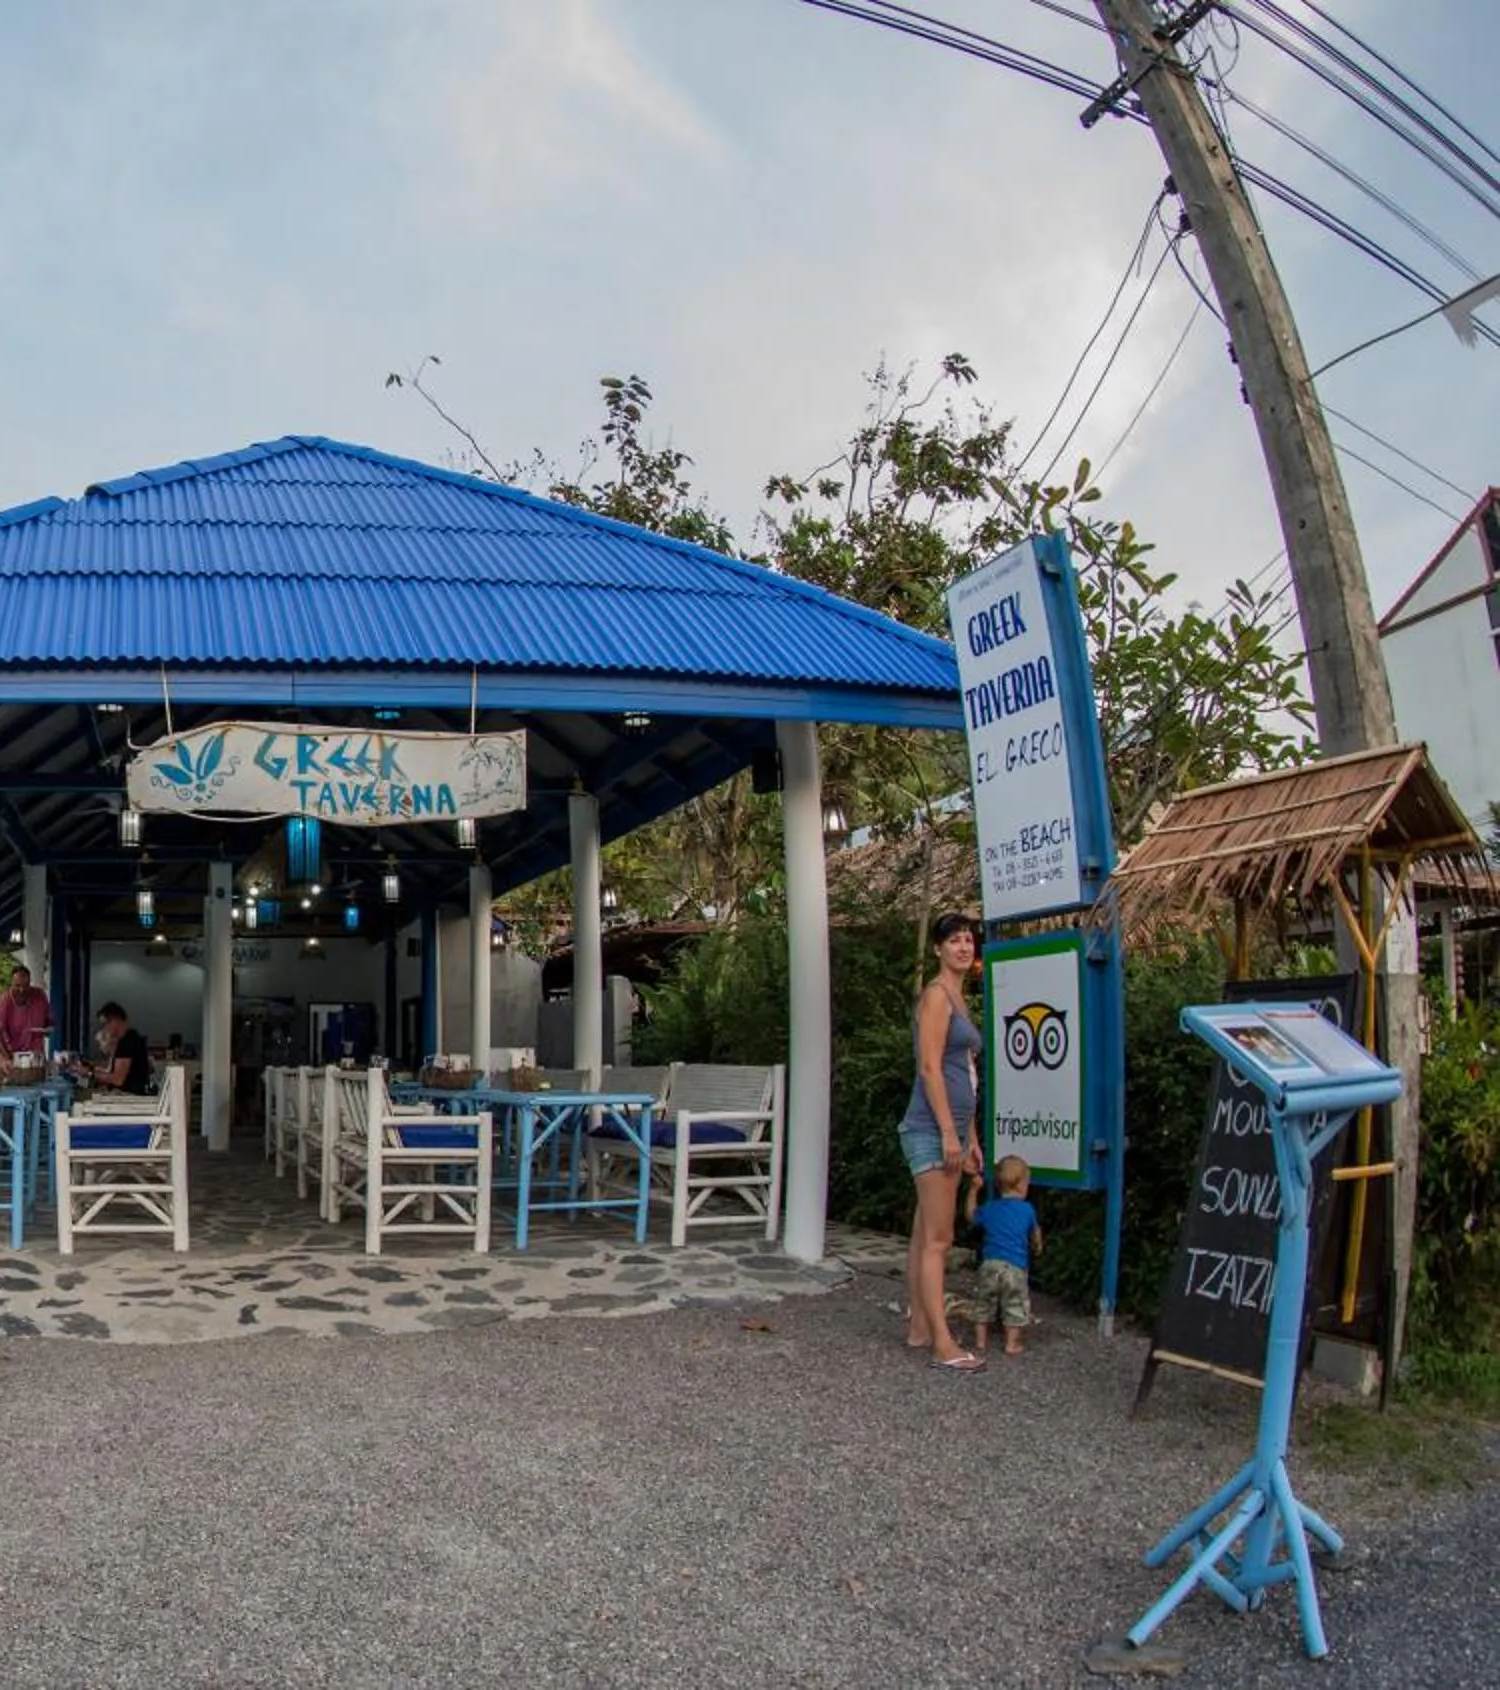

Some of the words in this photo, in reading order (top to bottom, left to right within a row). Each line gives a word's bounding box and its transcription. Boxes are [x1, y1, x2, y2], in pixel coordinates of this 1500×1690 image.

[968, 591, 1028, 658] GREEK
[965, 655, 1055, 730] TAVERNA
[253, 734, 410, 782] GREEK
[976, 747, 999, 786] EL
[1005, 722, 1063, 774] GRECO
[289, 779, 457, 816] TAVERNA
[1020, 816, 1071, 853] BEACH
[995, 1110, 1078, 1142] tripadvisor
[1201, 1165, 1282, 1220] SOUVL
